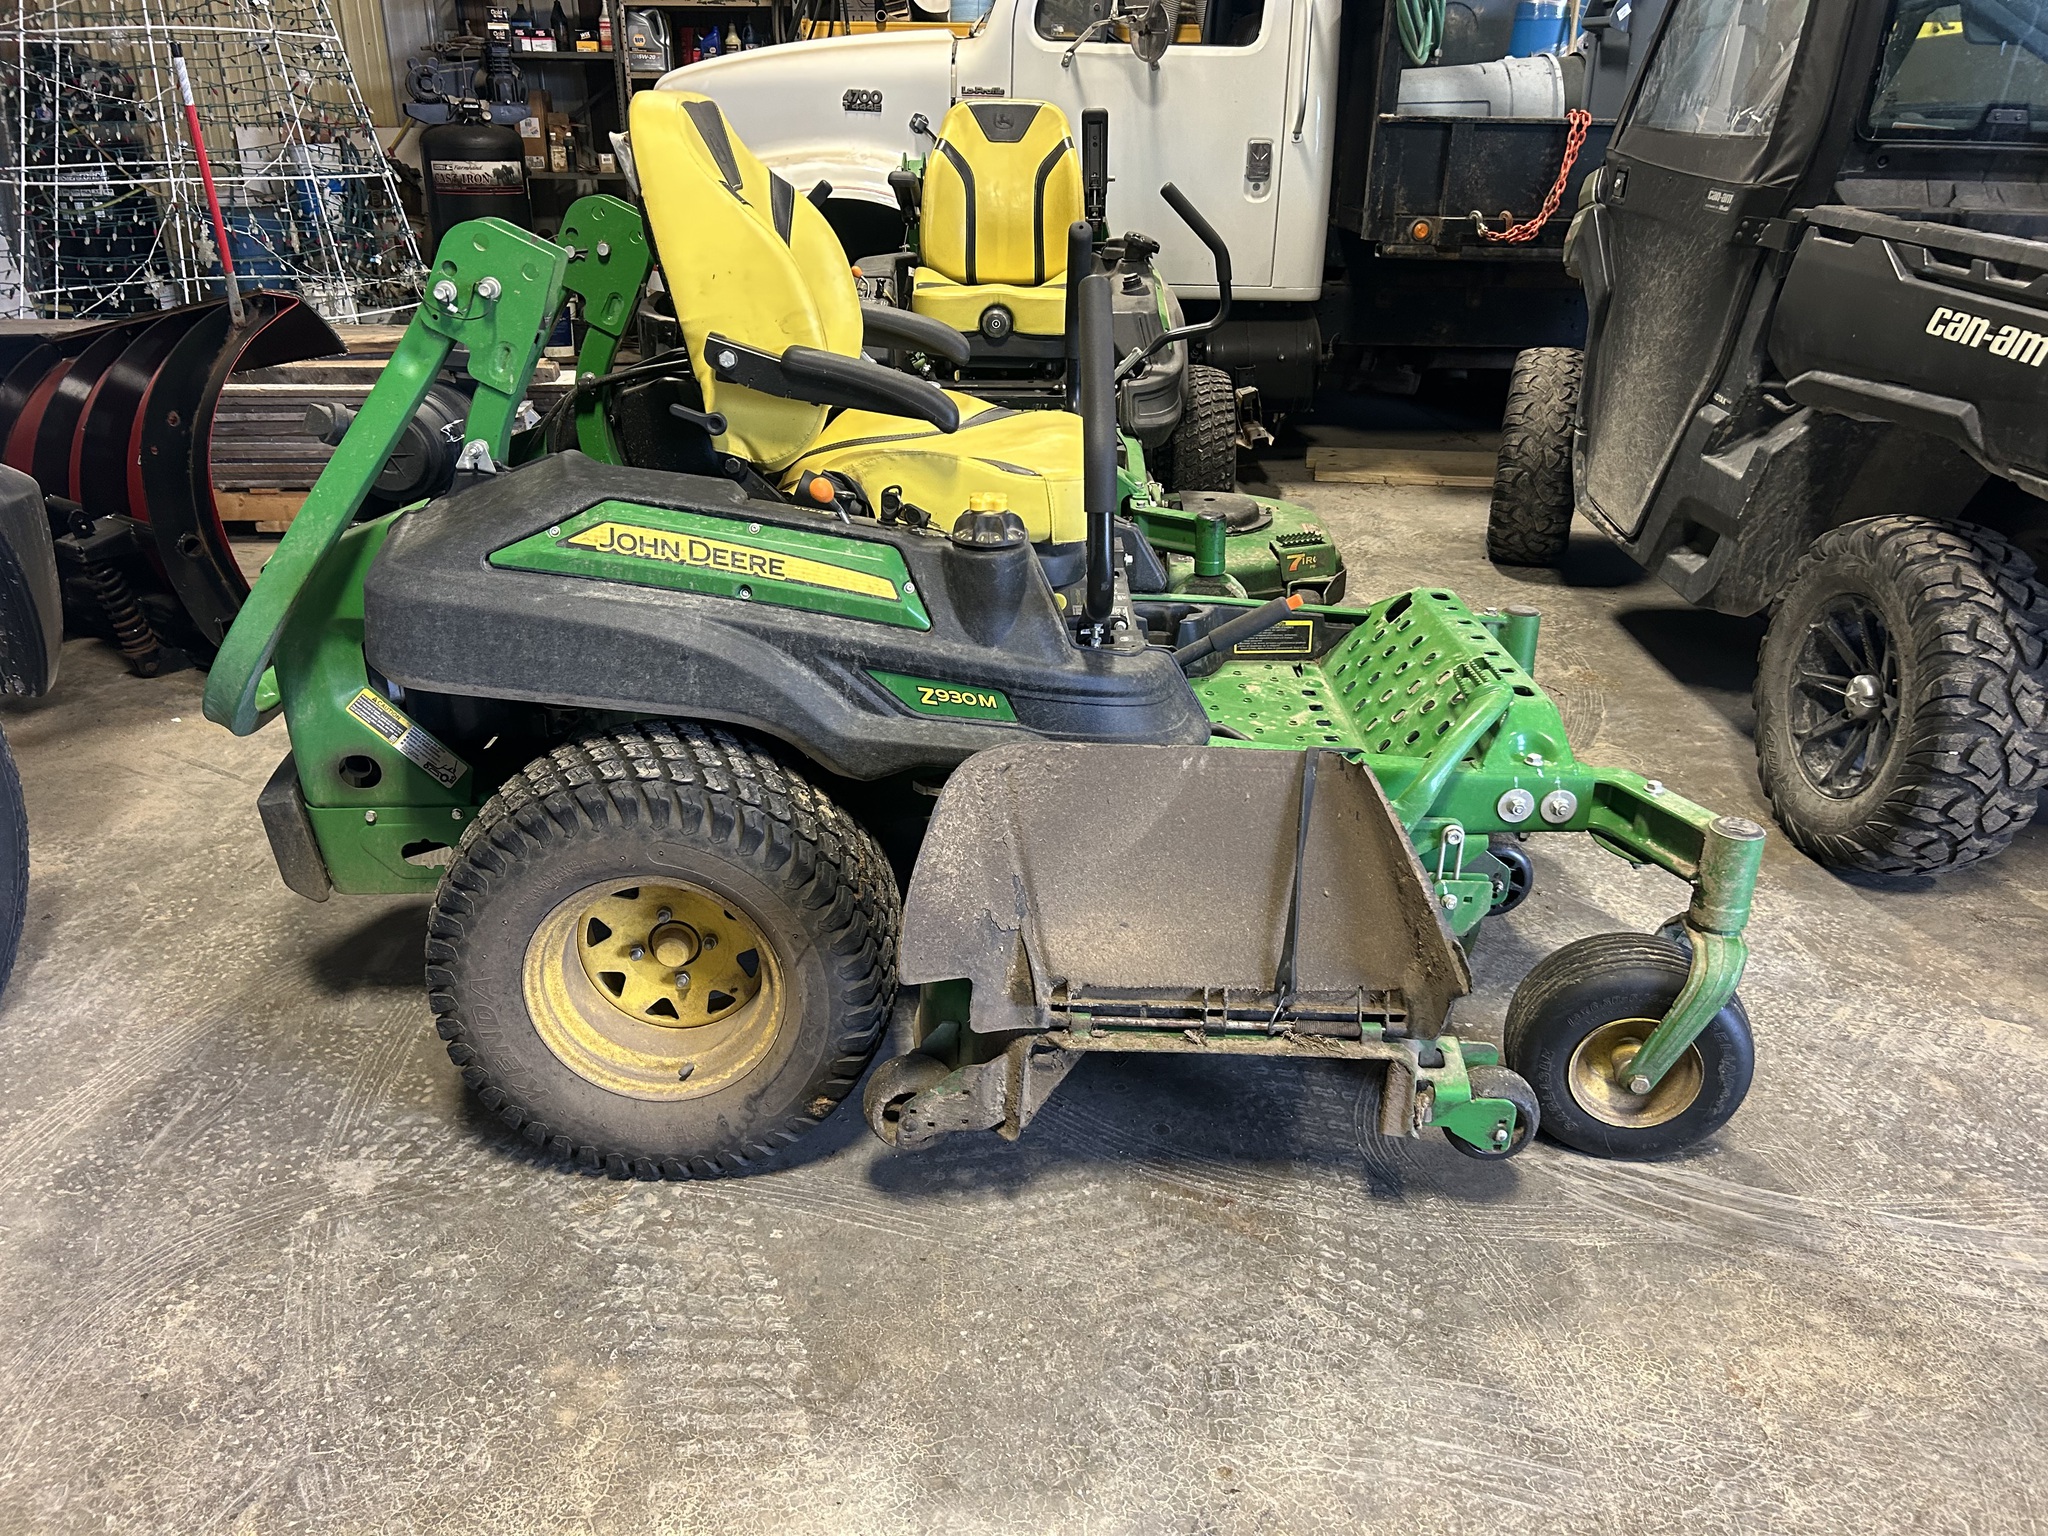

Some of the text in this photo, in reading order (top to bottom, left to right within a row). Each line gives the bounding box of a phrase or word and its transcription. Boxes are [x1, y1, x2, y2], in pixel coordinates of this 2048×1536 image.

[843, 89, 883, 103] 4700
[434, 172, 492, 184] CAST IRON
[1925, 306, 2048, 367] can-am
[600, 527, 785, 577] JOHN DEERE
[917, 686, 998, 709] Z930M
[376, 699, 401, 721] CAUTION
[469, 977, 551, 1102] KENDA
